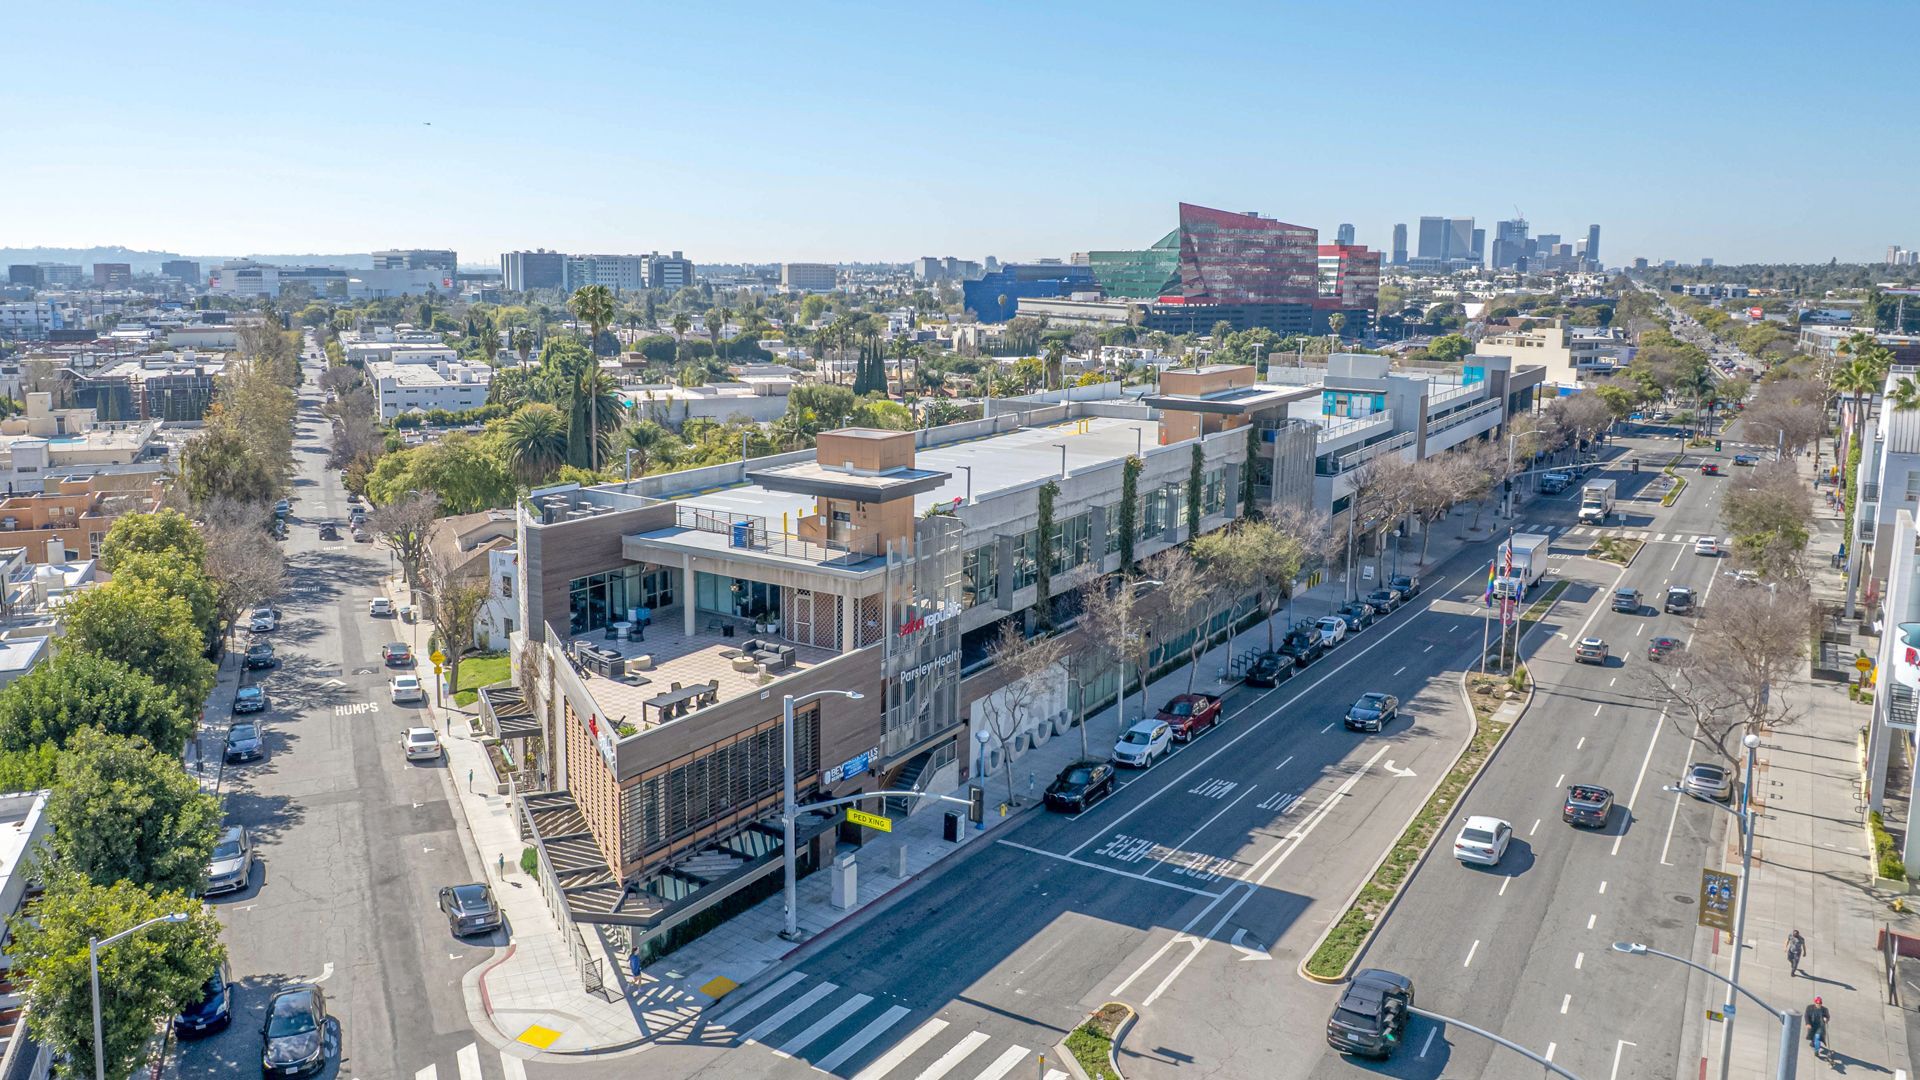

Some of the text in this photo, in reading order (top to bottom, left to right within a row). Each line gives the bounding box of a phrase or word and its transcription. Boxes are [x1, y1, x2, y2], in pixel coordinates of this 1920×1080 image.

[900, 648, 963, 684] Parsley Health
[335, 702, 379, 716] HUMPS
[1188, 778, 1238, 799] WAIT
[853, 813, 885, 827] PED XING
[1094, 833, 1160, 863] HERE
